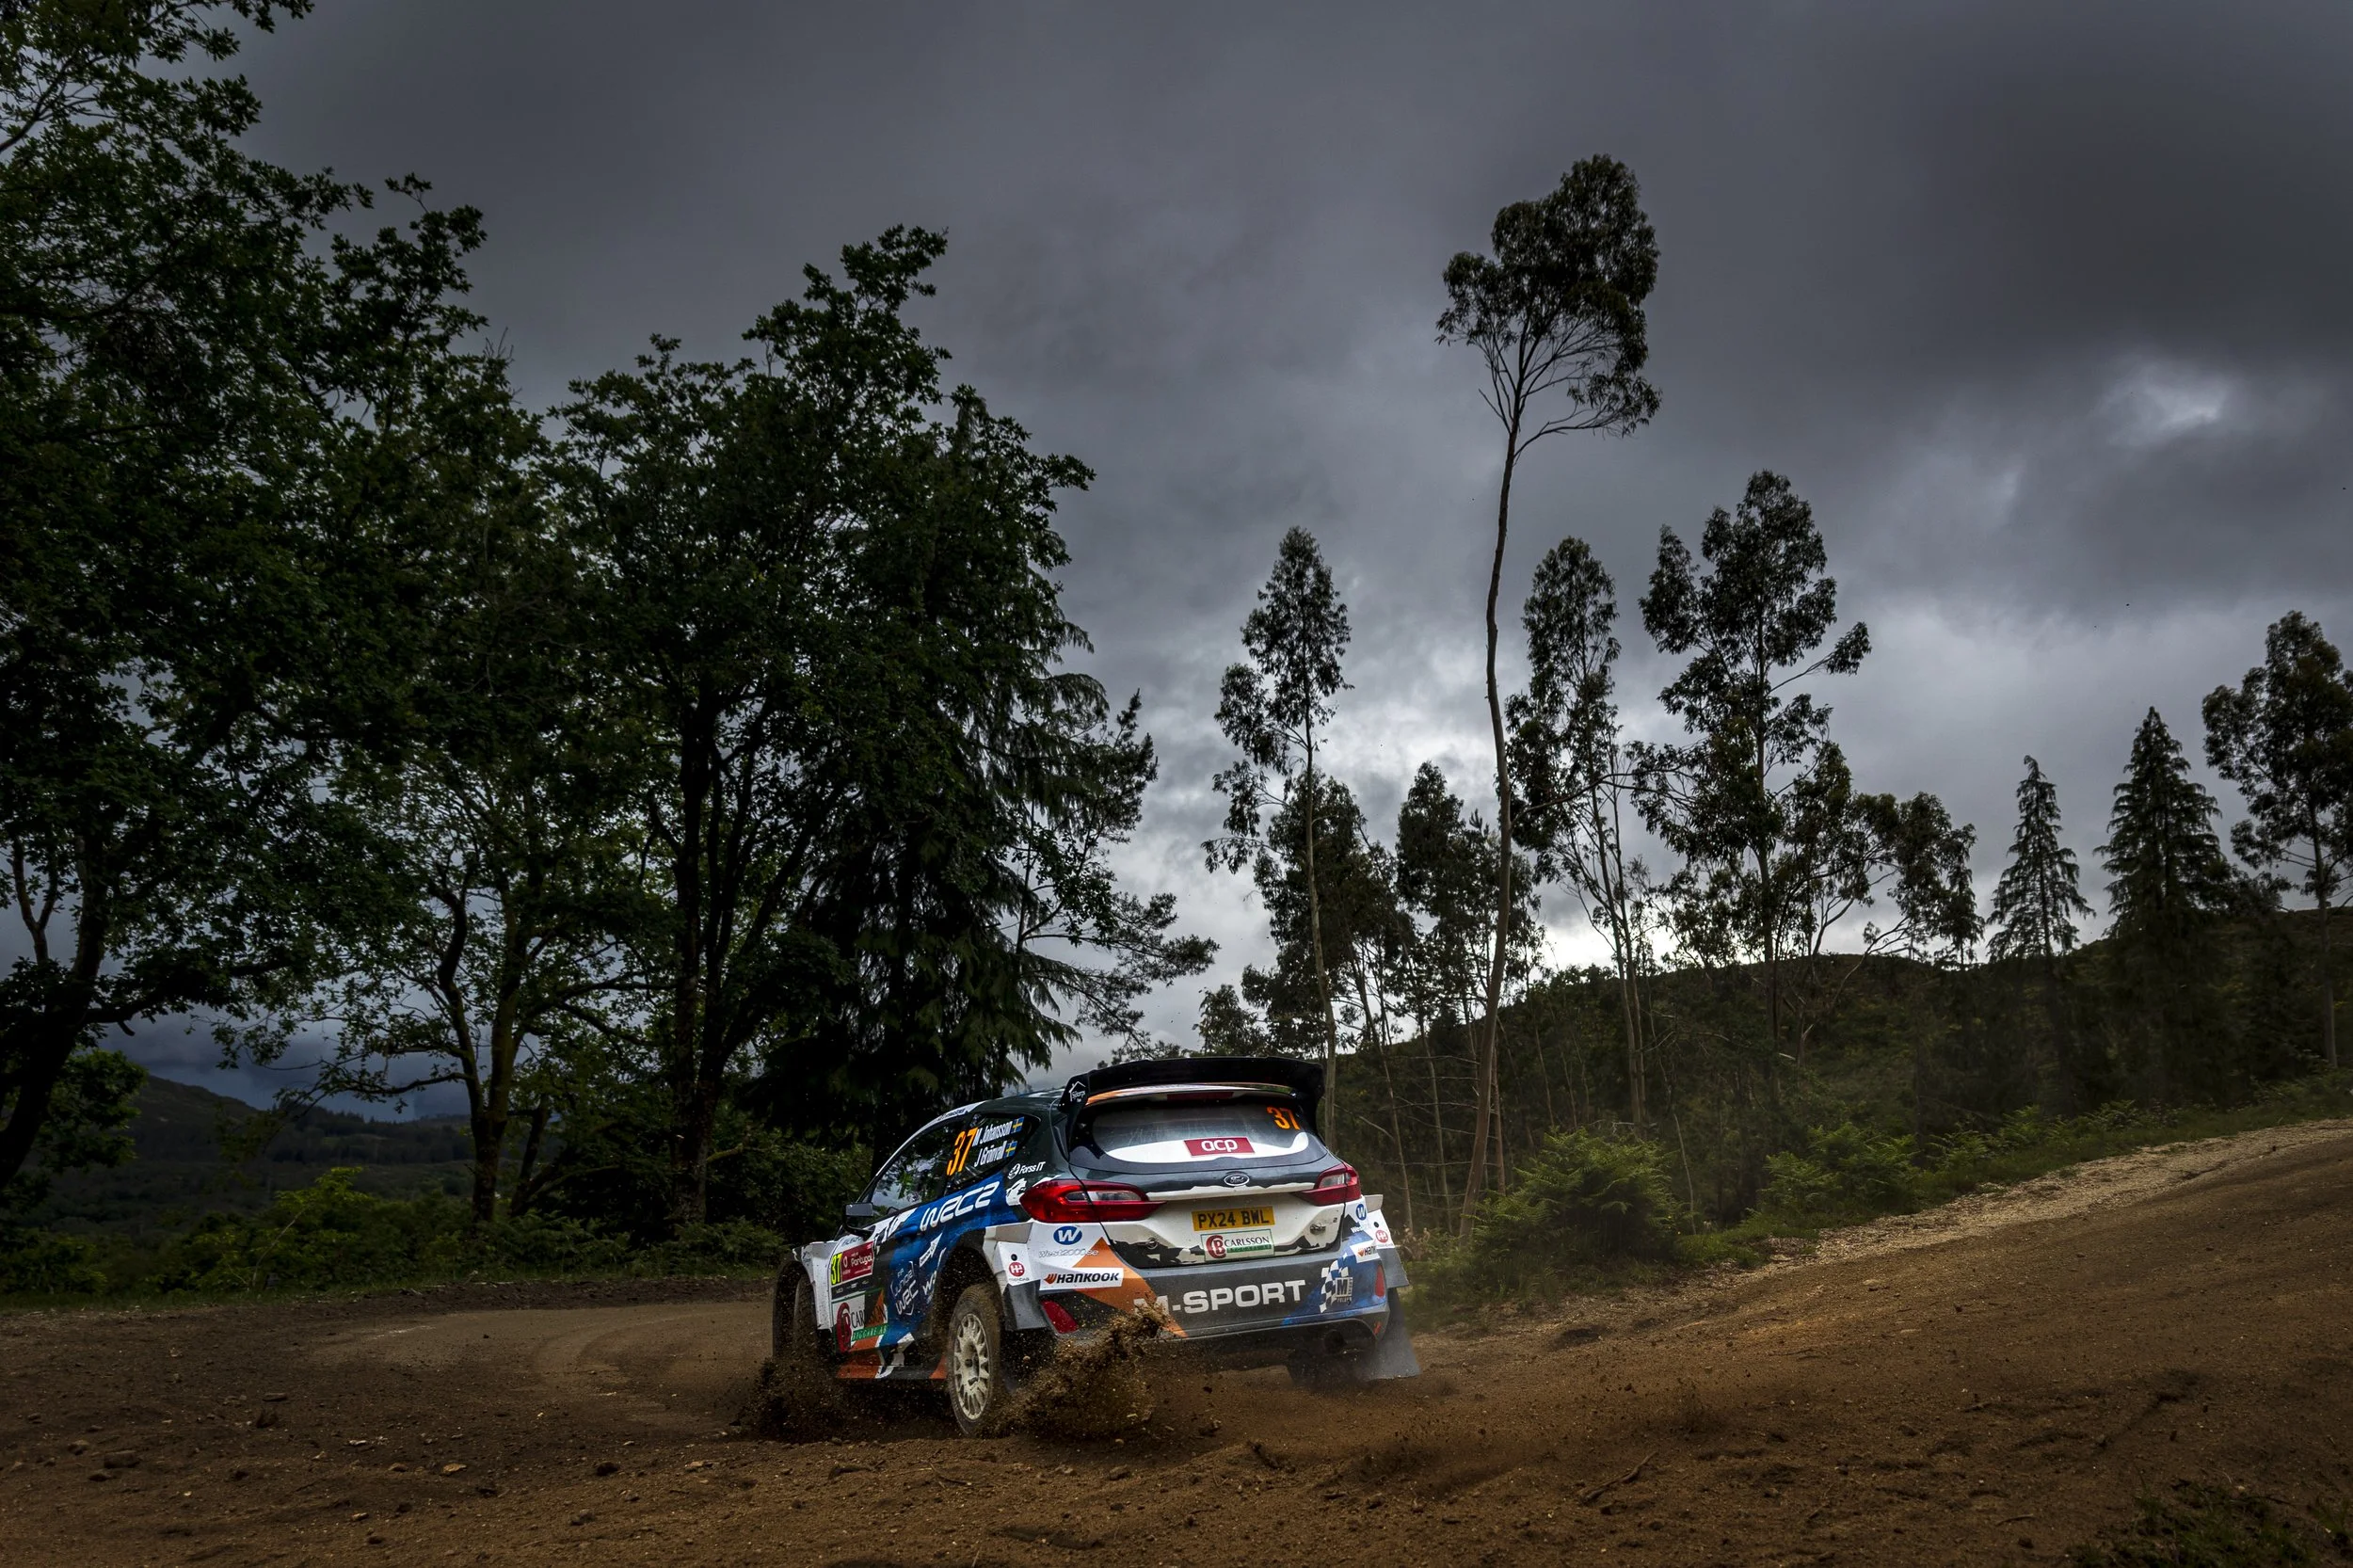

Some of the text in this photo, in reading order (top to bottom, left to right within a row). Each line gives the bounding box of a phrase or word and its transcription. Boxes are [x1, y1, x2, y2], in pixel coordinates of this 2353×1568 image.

[1266, 1106, 1301, 1130] 37
[946, 1127, 979, 1176] 37
[1201, 1139, 1239, 1152] acp
[1198, 1209, 1270, 1228] PX24 BWL
[1225, 1236, 1270, 1247] CARLSSON
[831, 1253, 842, 1285] 37
[851, 1253, 872, 1267] Portugal
